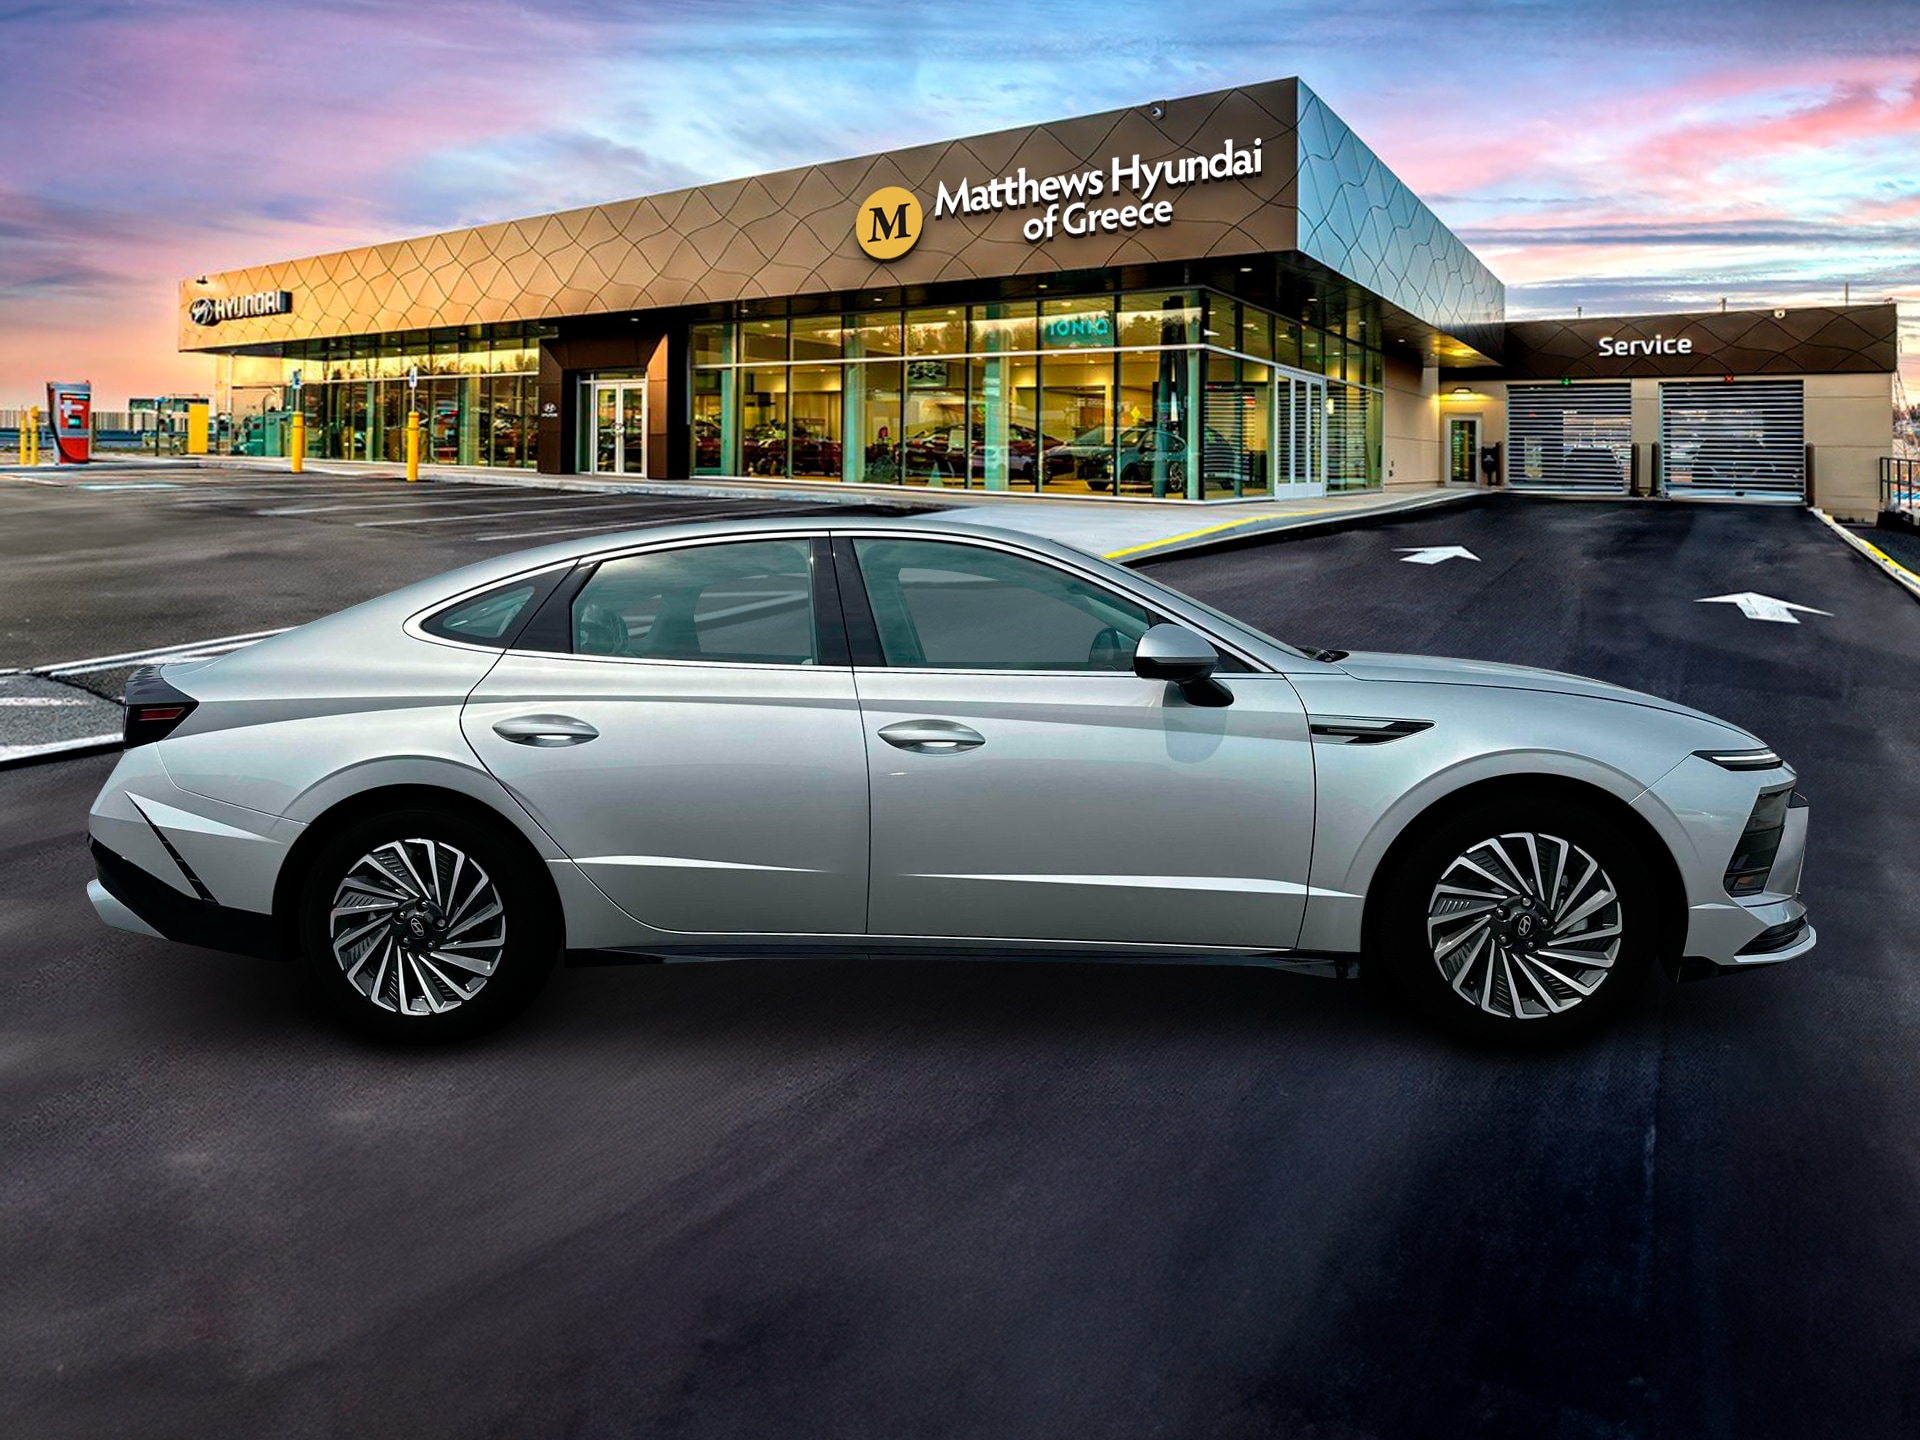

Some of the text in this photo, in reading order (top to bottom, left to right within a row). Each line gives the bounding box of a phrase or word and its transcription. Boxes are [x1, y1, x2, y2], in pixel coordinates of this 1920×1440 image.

[934, 137, 1262, 217] Matthews Hyundai
[867, 203, 912, 243] M
[1023, 200, 1173, 240] of Greece
[215, 290, 281, 320] HYUNDAI
[1598, 334, 1693, 357] Service
